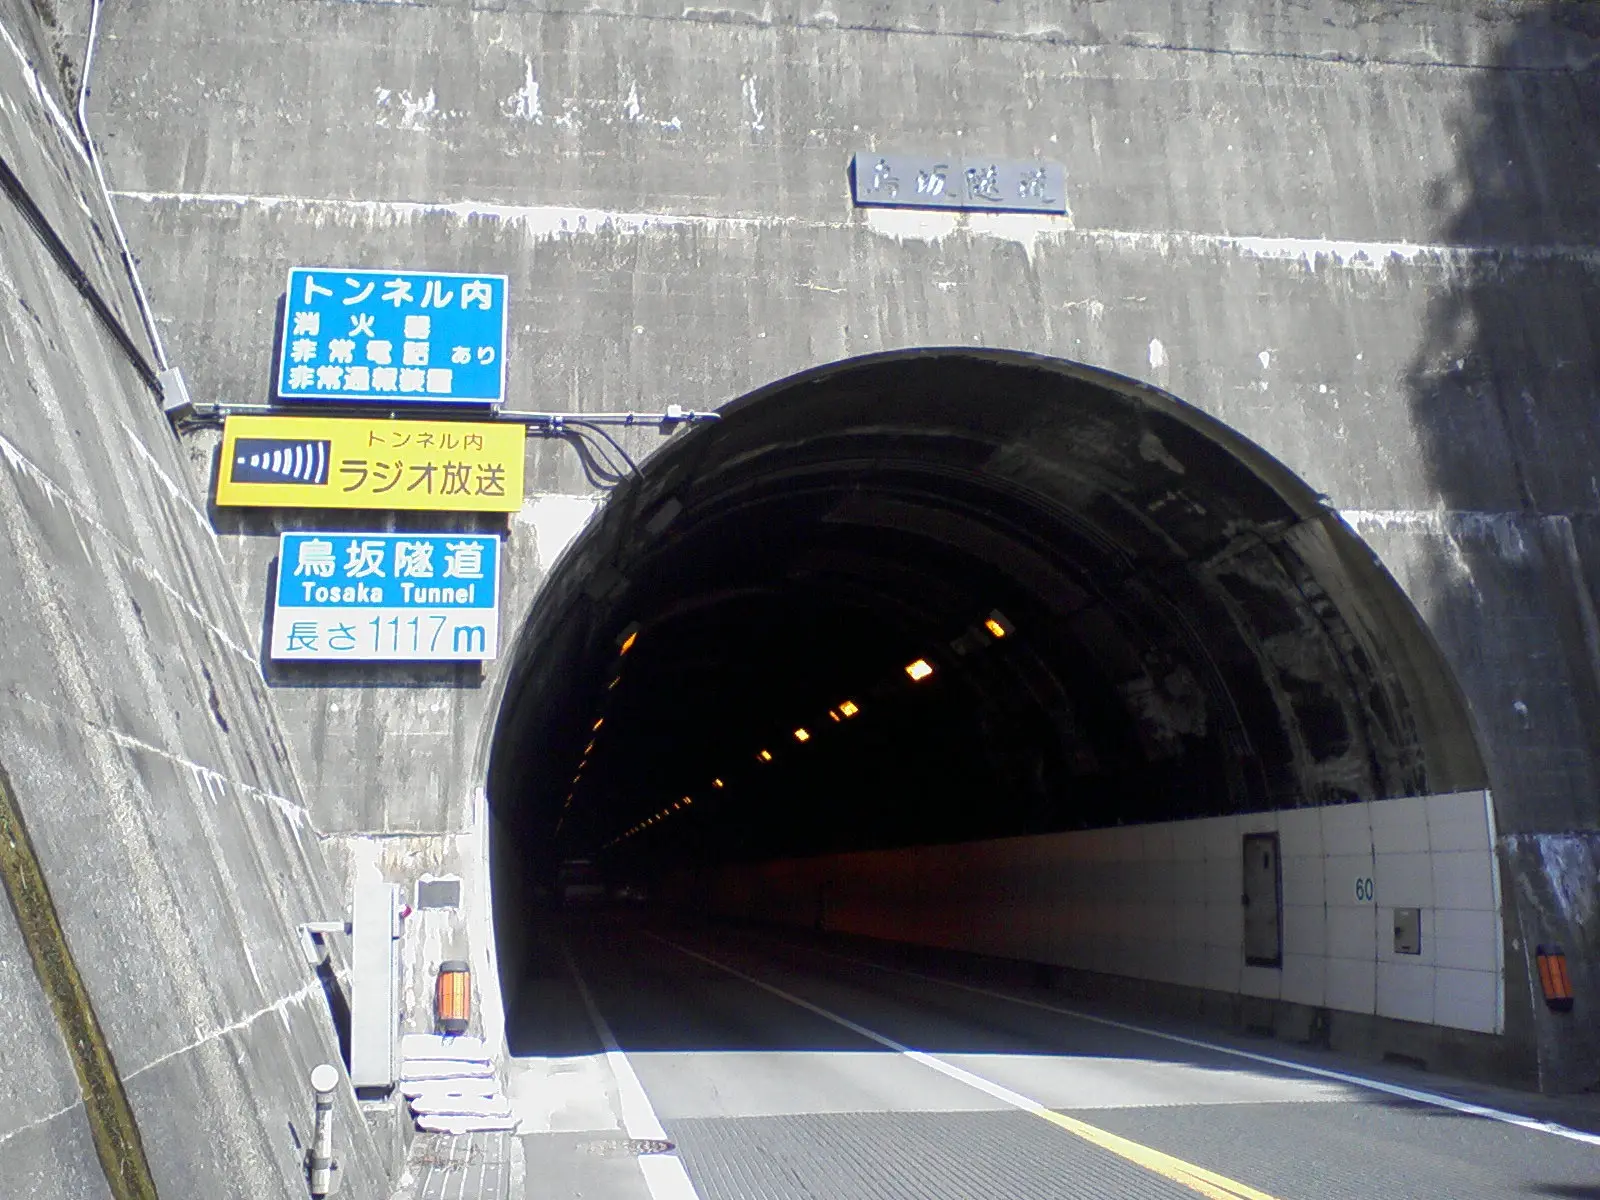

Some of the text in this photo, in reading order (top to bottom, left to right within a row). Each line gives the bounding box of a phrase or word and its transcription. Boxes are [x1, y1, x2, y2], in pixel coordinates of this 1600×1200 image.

[304, 275, 492, 310] トンネル内
[452, 345, 495, 365] あり
[368, 429, 483, 451] トンネル内
[339, 459, 506, 497] ラジオ放送
[293, 538, 485, 579] 鳥坂隧道
[301, 581, 475, 604] Tosaka Tunnel
[1355, 878, 1374, 901] 60
